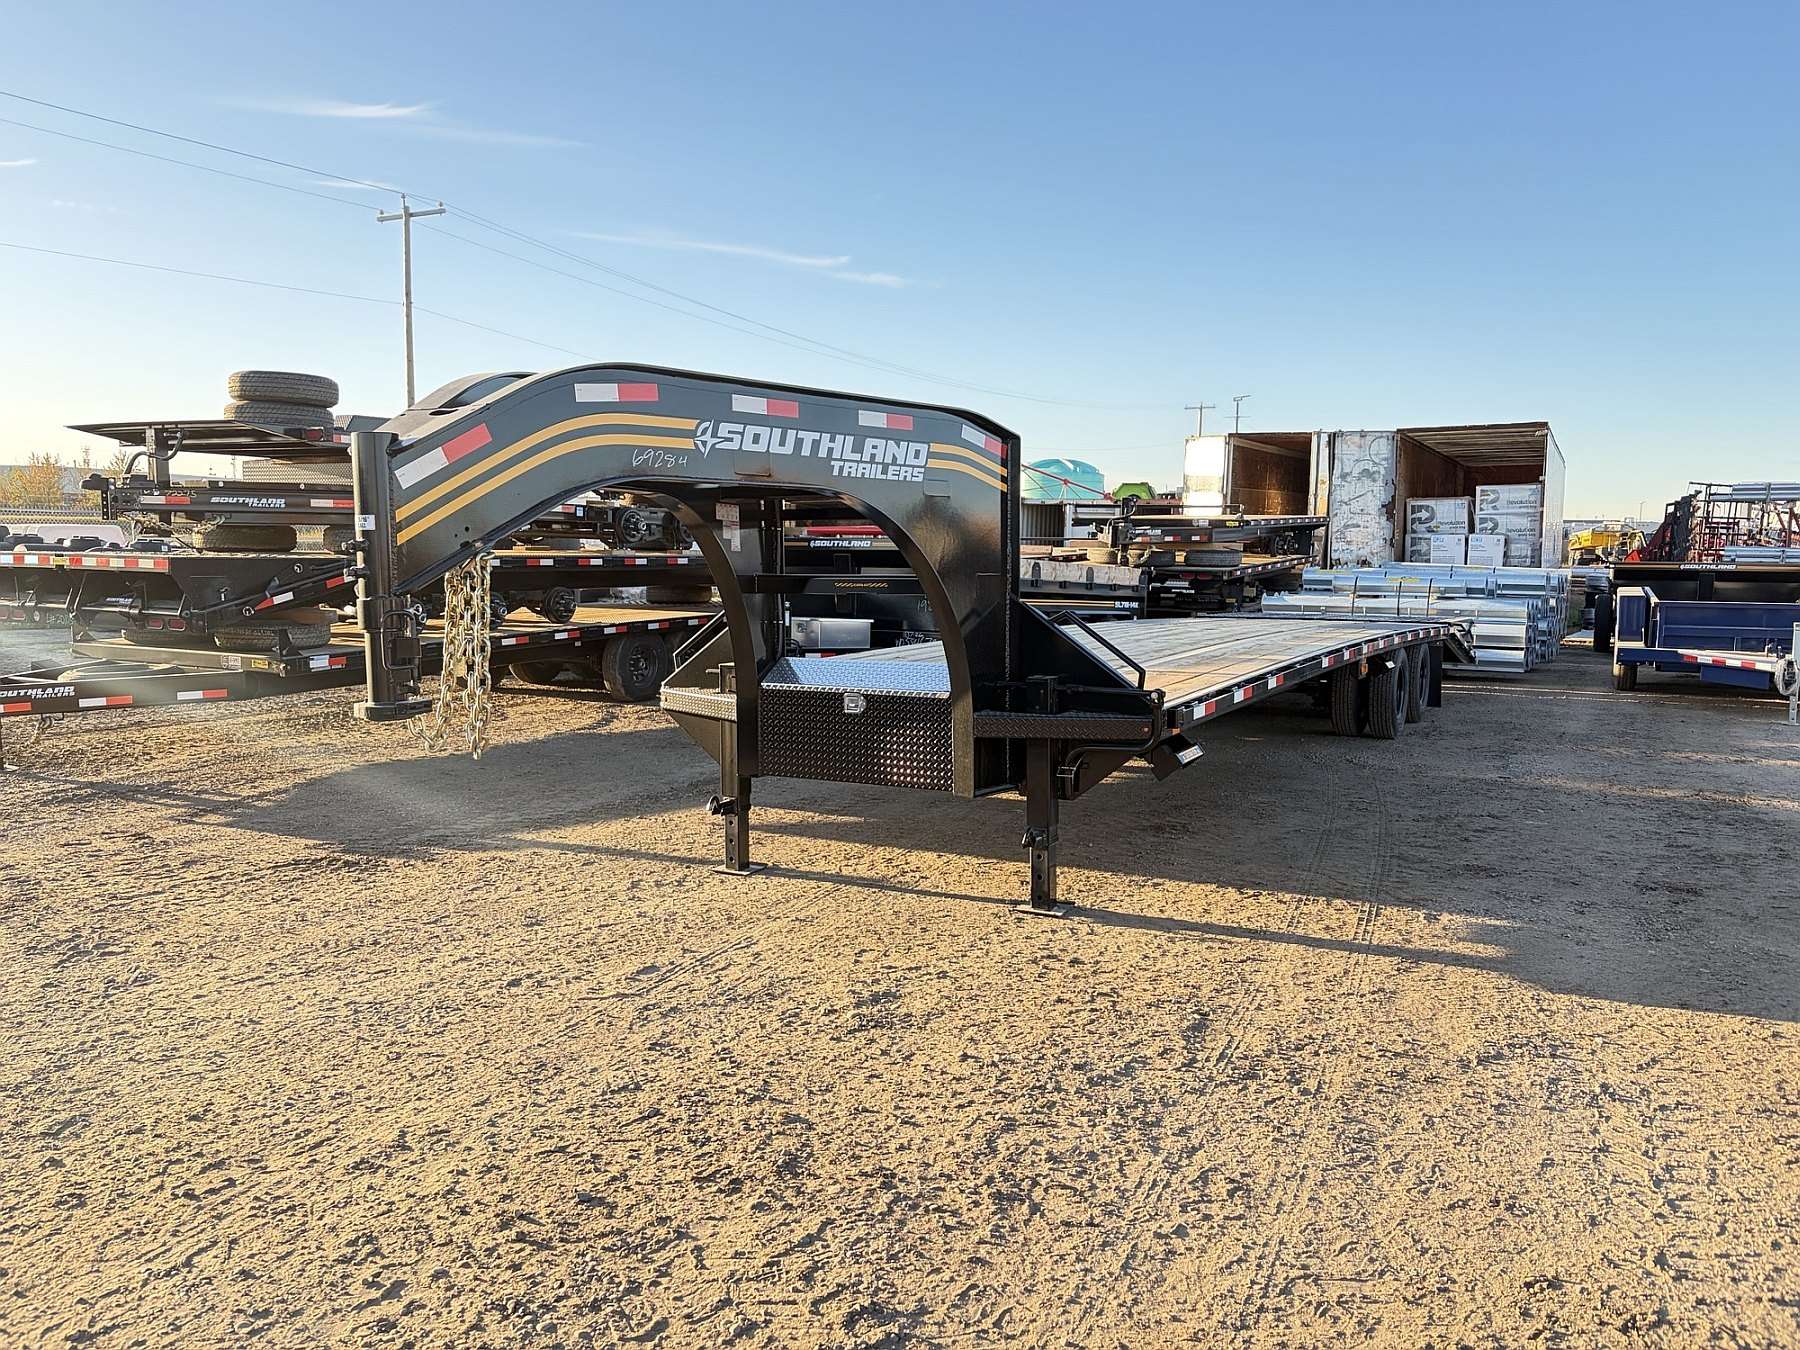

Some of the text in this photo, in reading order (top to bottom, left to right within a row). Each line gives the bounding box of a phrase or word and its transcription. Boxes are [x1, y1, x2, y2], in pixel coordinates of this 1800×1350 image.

[715, 422, 930, 467] SOUTHLAND
[632, 448, 688, 468] 69284
[830, 460, 925, 482] TRAILERS
[210, 496, 286, 505] SOUTHLAND
[0, 686, 75, 698] OUTHLAND
[31, 691, 76, 699] TRAILERS
